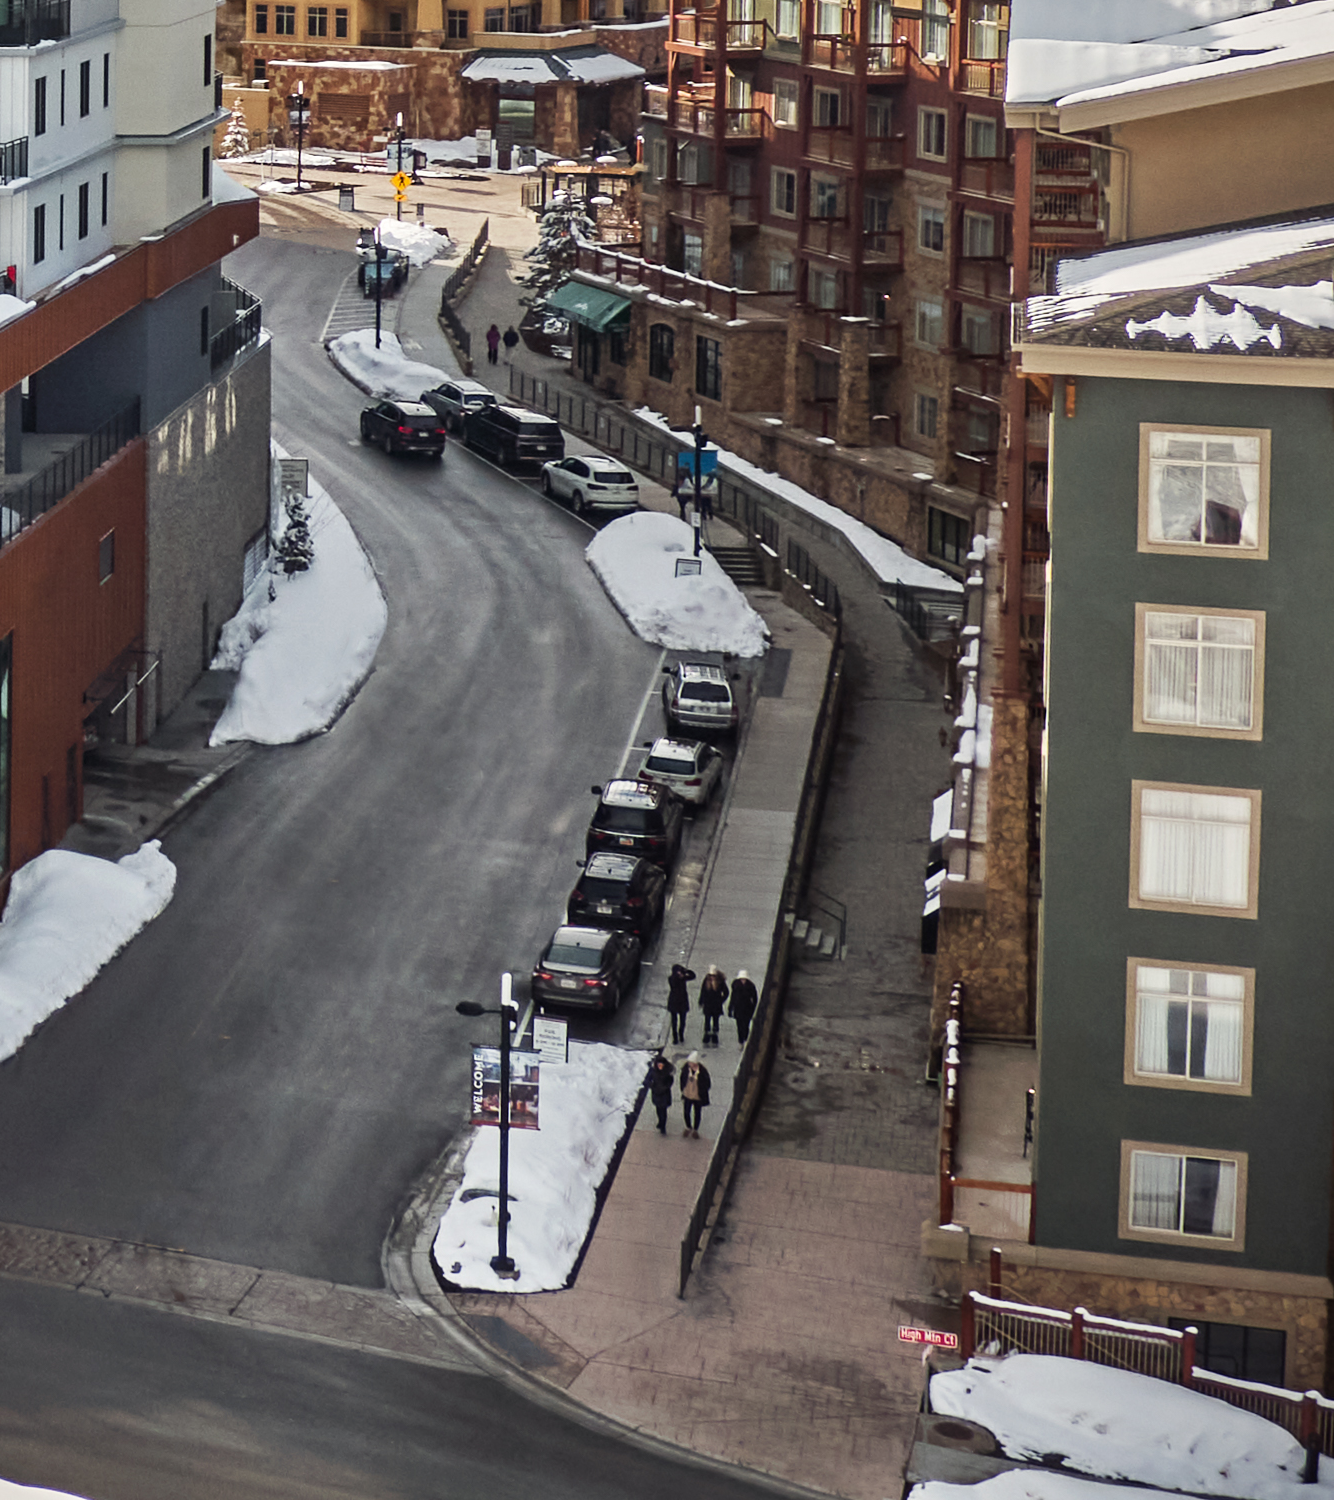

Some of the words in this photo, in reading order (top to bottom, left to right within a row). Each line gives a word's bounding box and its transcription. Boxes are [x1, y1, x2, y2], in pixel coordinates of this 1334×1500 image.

[473, 1054, 484, 1114] WELCOME
[901, 1327, 922, 1342] High
[944, 1333, 955, 1346] Ct
